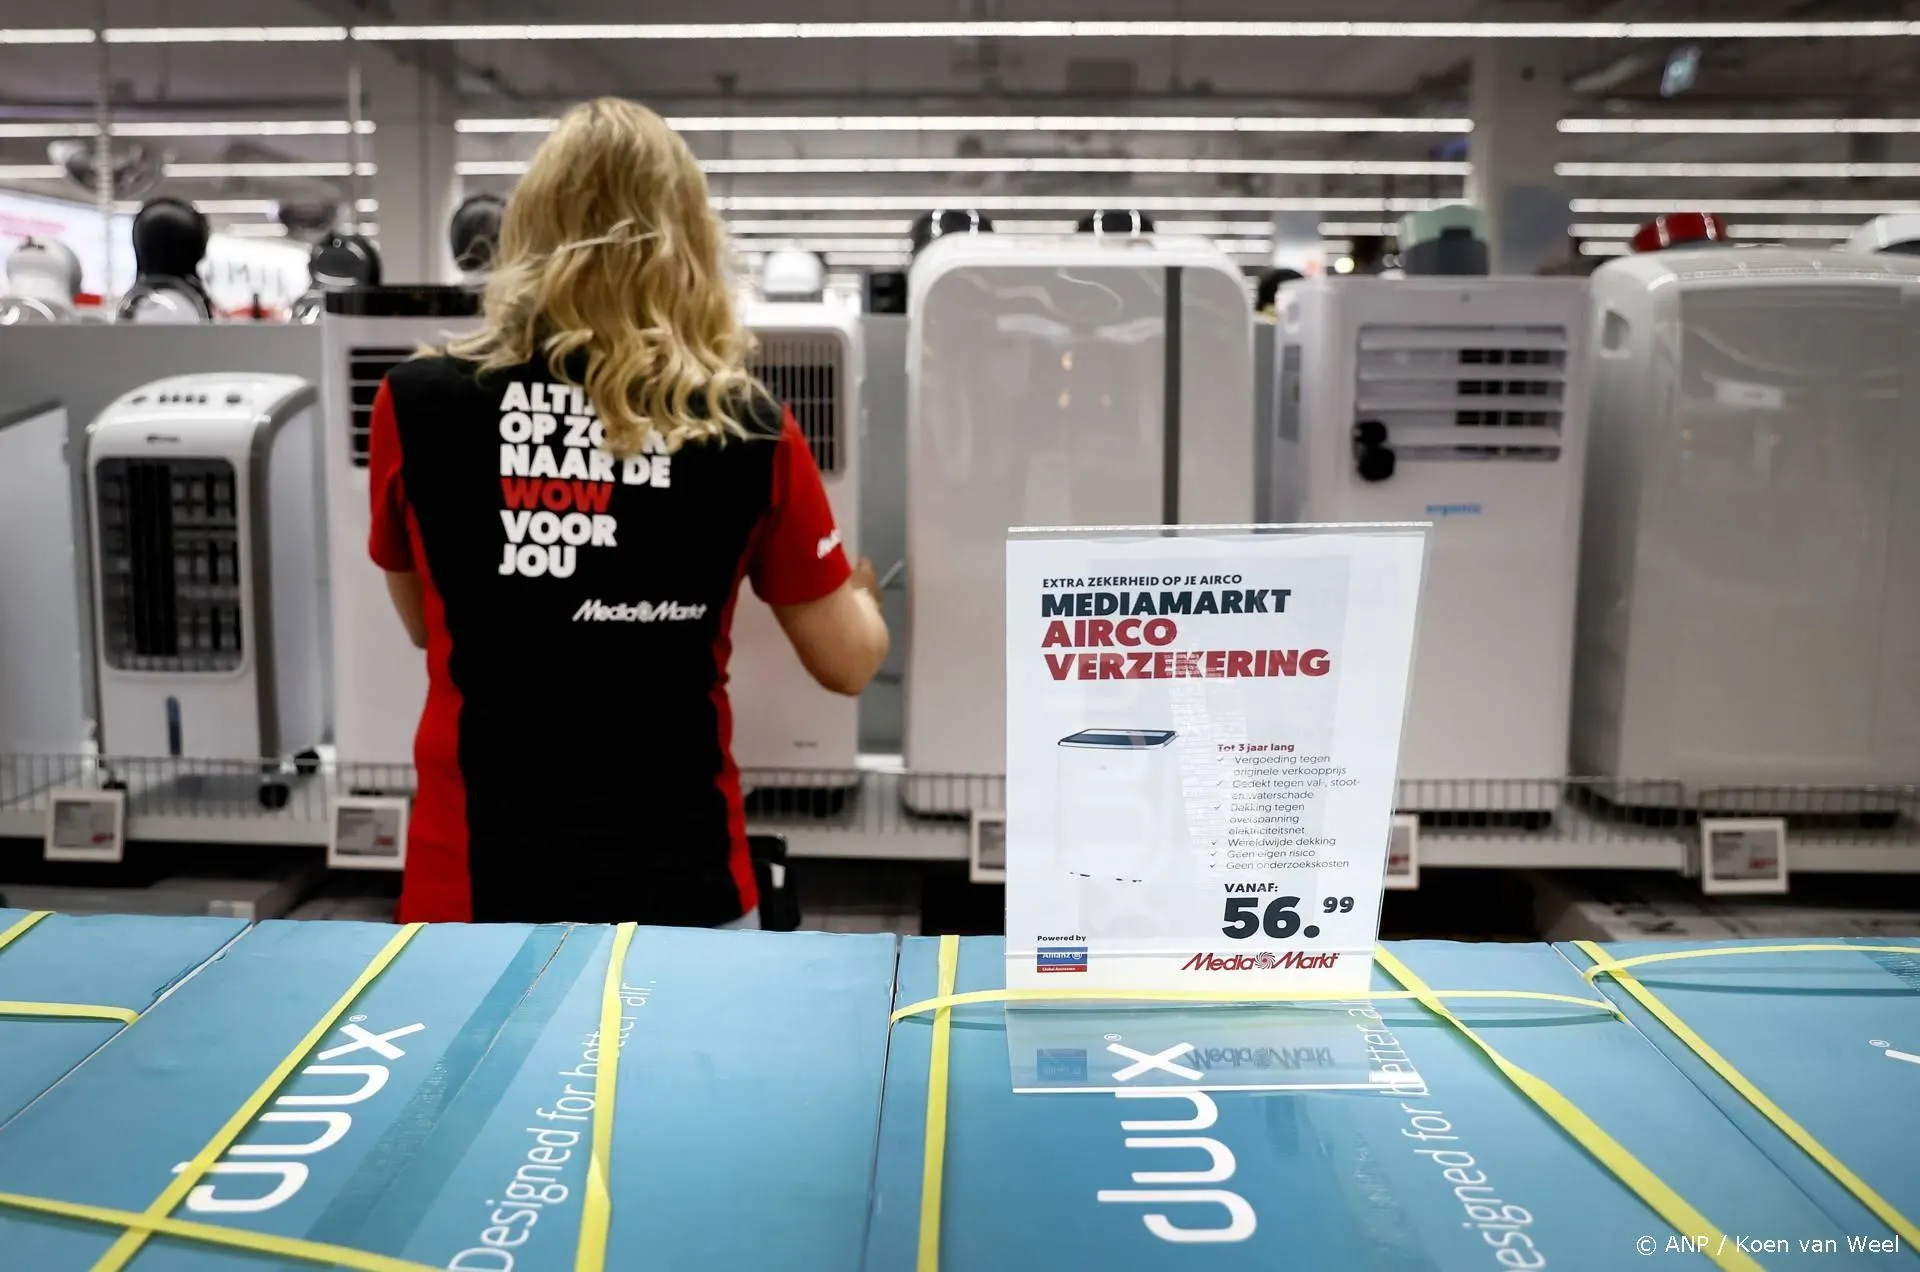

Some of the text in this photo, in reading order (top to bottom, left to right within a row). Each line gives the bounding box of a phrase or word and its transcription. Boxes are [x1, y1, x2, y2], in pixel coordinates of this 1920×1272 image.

[499, 411, 557, 444] OP
[500, 443, 672, 488] NAAR DE
[501, 477, 614, 513] WOW
[500, 510, 617, 547] VOOR
[498, 543, 577, 578] JOU
[1043, 575, 1242, 588] EXTRA ZEKERHEID OP JE AIRCO
[1041, 589, 1291, 617] MEDIAMARKT
[1041, 618, 1177, 647] AIRCO
[1044, 649, 1331, 680] VERZEKERING
[1217, 743, 1295, 753] Tot 3 jaar lang
[1235, 755, 1330, 765] Vergoeding tegen
[1233, 766, 1347, 777] originele verkoopprijs
[1232, 779, 1270, 788] Gedekt
[1273, 780, 1304, 789] tegen
[1275, 804, 1305, 812] tegen
[1228, 838, 1336, 848] Wereldwijde dekking
[1226, 851, 1255, 859] Geen
[1289, 849, 1316, 858] risico
[1226, 861, 1349, 870] Geen onderzoekskosten
[1224, 883, 1278, 893] VANAF:
[1323, 896, 1354, 913] 99
[1076, 934, 1087, 942] by
[1401, 1103, 1459, 1141] for
[447, 1127, 581, 1272] Designed
[536, 1083, 596, 1121] for
[1413, 1149, 1546, 1272] esigned
